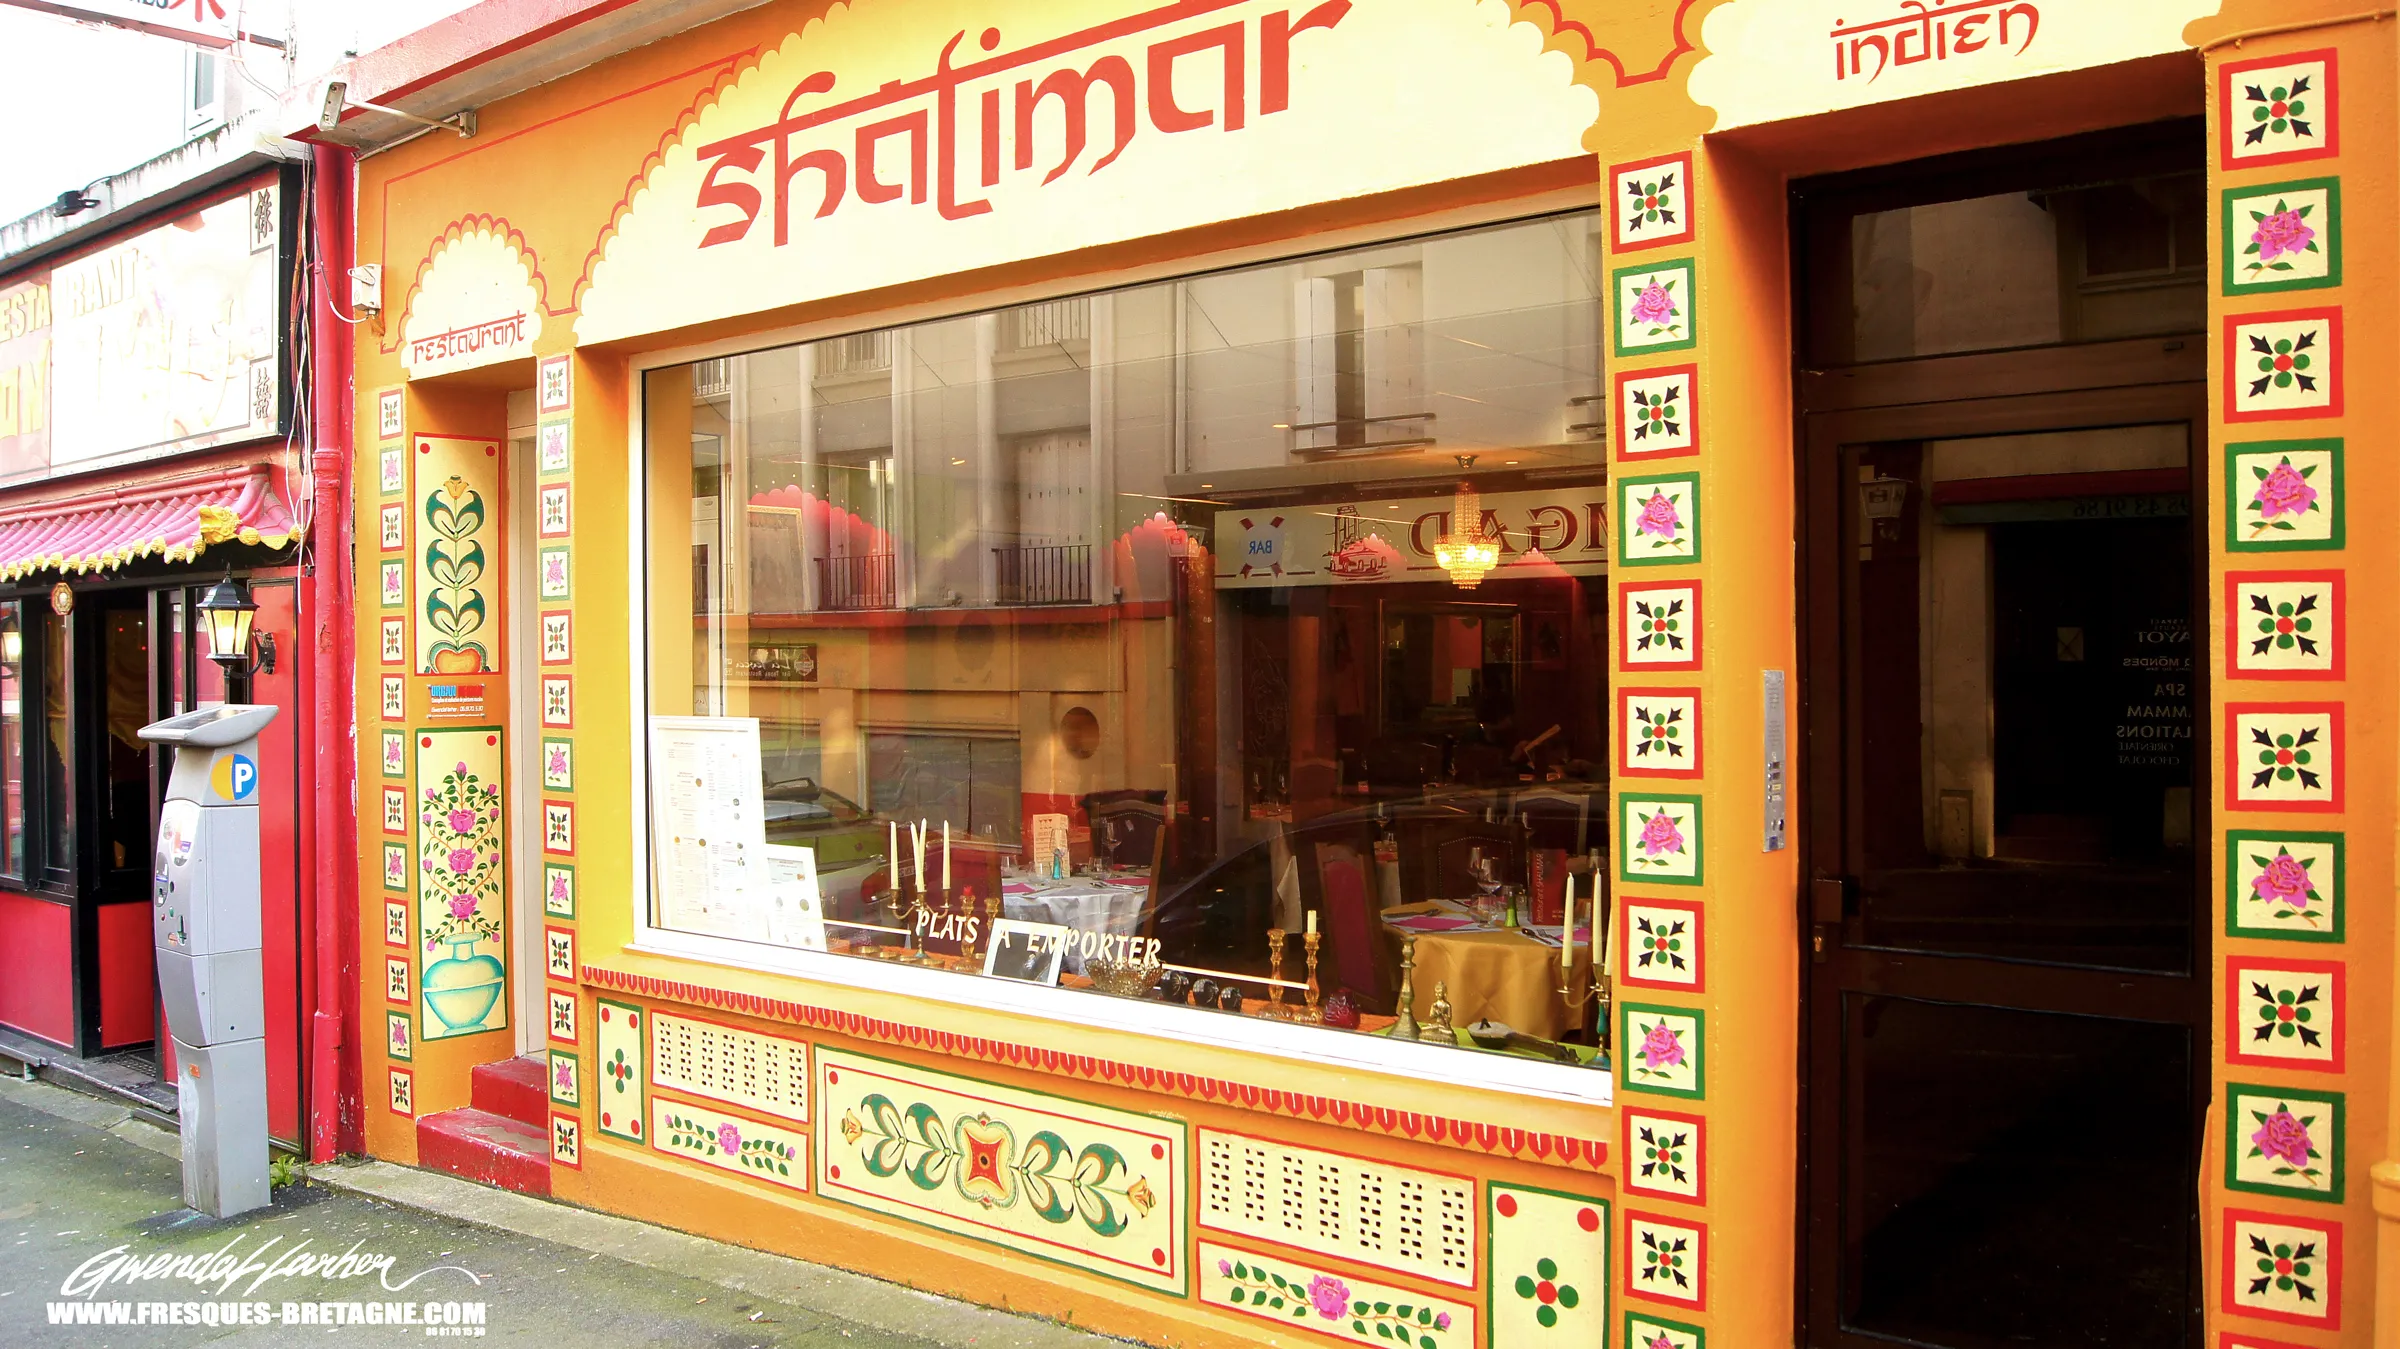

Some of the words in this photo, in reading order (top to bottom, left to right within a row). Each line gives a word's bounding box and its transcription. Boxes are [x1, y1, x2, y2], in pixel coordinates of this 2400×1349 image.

[411, 309, 527, 364] restaurant
[235, 764, 253, 793] P
[916, 910, 980, 944] PLATS
[1027, 928, 1162, 968] EMPORTER
